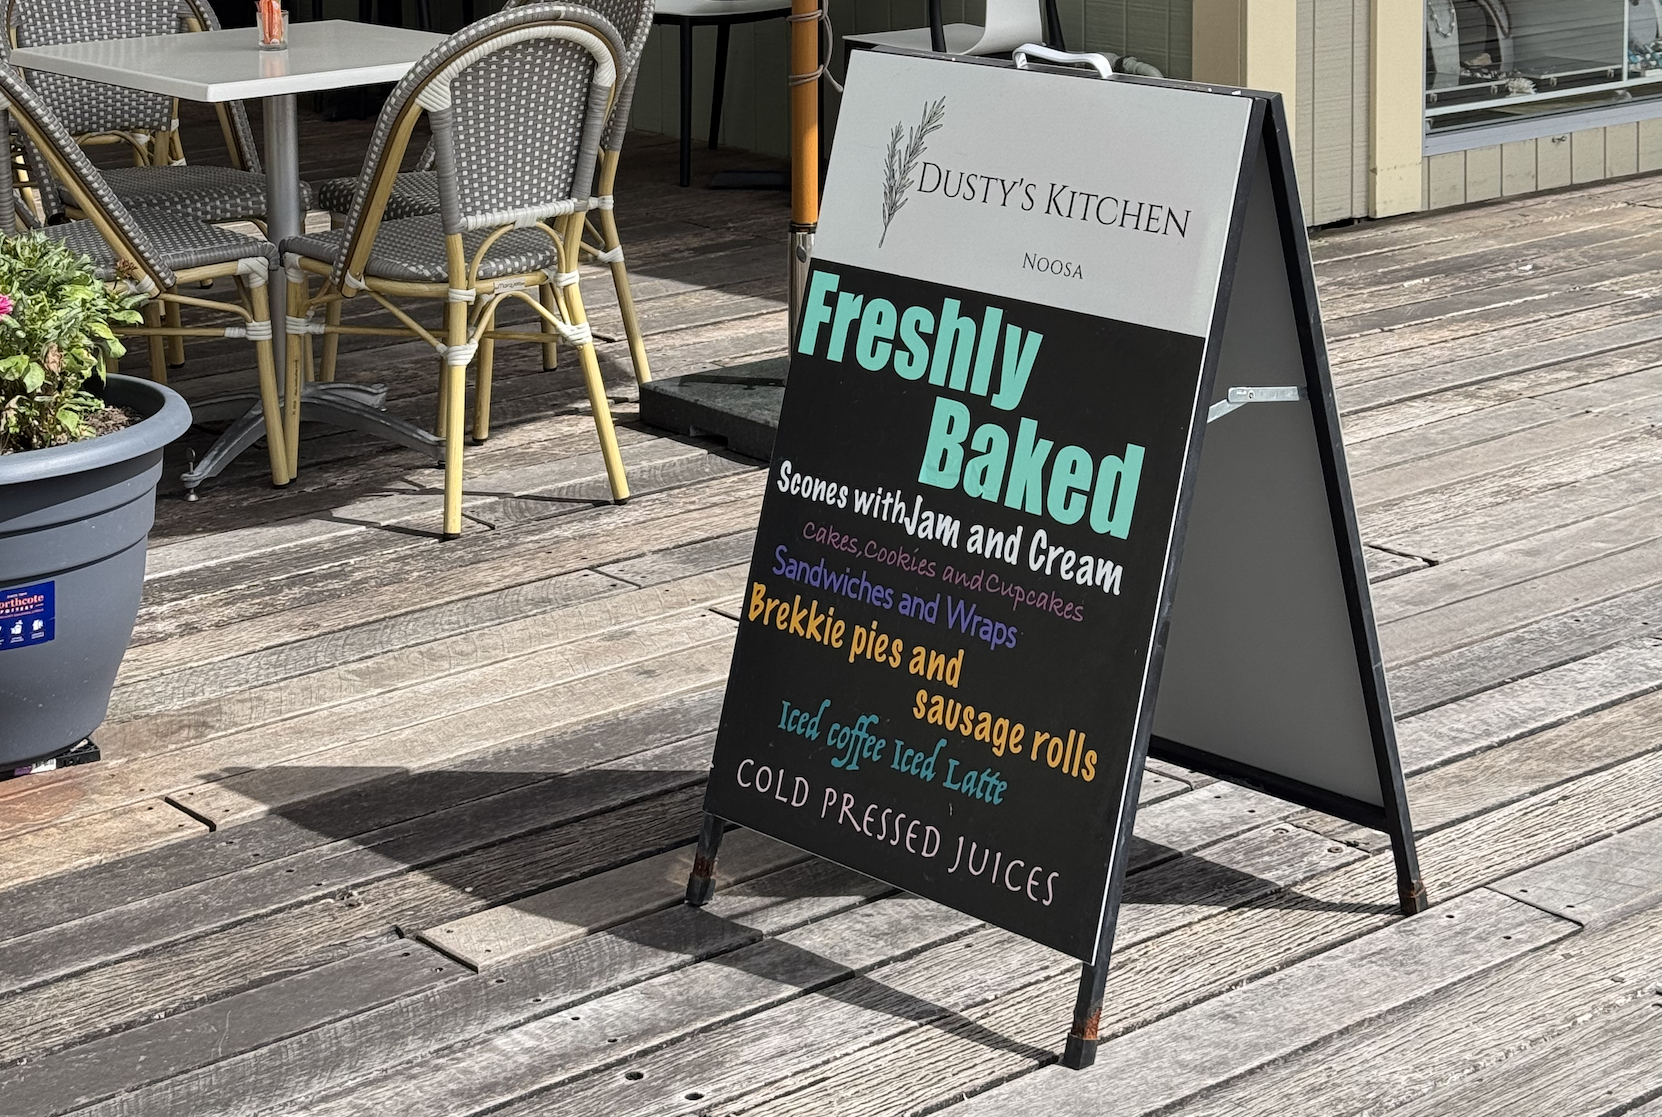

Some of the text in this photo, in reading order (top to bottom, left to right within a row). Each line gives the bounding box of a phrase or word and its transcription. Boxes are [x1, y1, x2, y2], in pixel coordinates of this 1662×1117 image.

[916, 161, 1192, 240] DUSTY'S KITCHEN
[797, 270, 1044, 412] Freshly
[917, 397, 1146, 541] Baked
[776, 459, 849, 509] Scones
[966, 524, 1024, 566] and
[1028, 528, 1123, 596] Cream
[0, 595, 45, 609] orthcote
[747, 581, 964, 689] Brekkie pies and
[772, 544, 1018, 650] Sandwiches and Wraps
[777, 698, 1008, 806] Iced coffee Iced Latte
[912, 688, 1098, 782] sausage rolls
[736, 758, 1060, 907] COLD PRESSED JUICES
